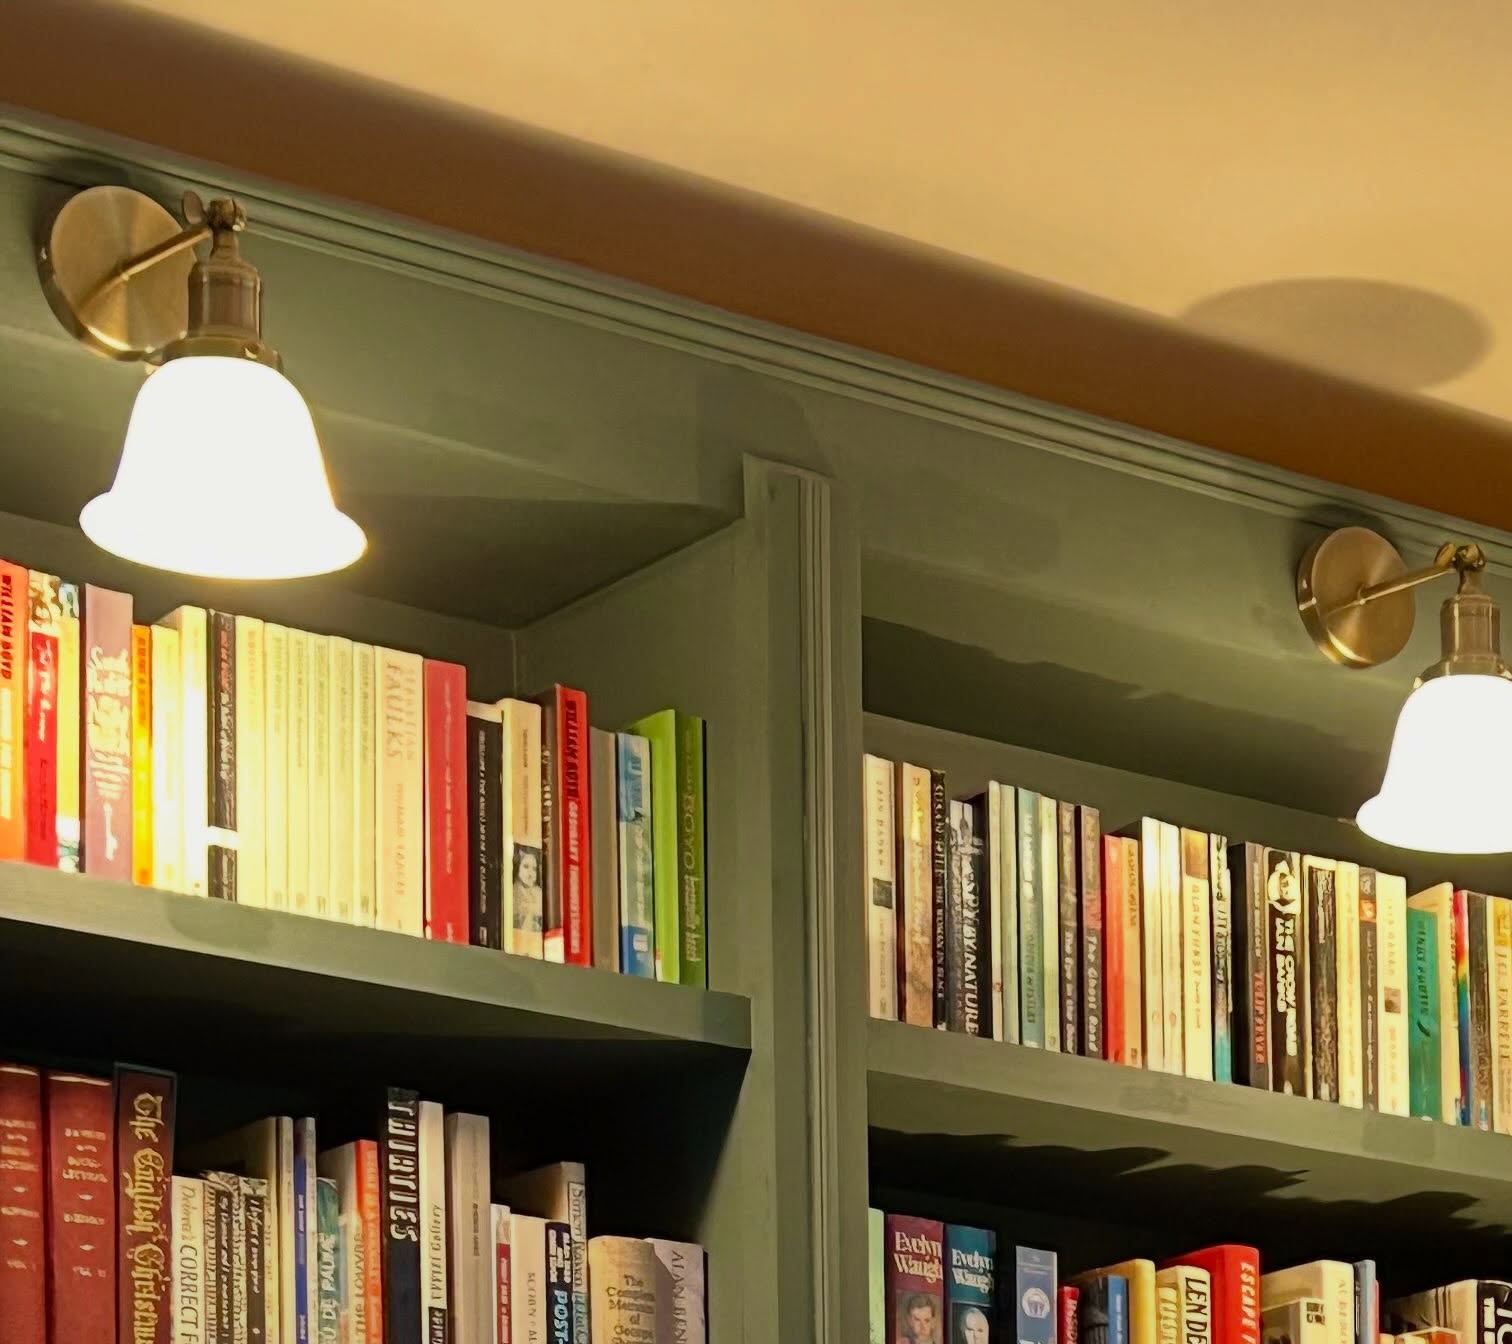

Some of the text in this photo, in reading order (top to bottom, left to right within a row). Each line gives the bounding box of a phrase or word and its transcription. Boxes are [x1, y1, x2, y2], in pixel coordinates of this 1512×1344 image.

[964, 955, 978, 1036] NATURE
[123, 1148, 164, 1233] English
[180, 1245, 199, 1330] CORRECT
[671, 1250, 685, 1300] ALAN
[1184, 1276, 1209, 1316] LEN
[1240, 1261, 1256, 1328] ESCAPE
